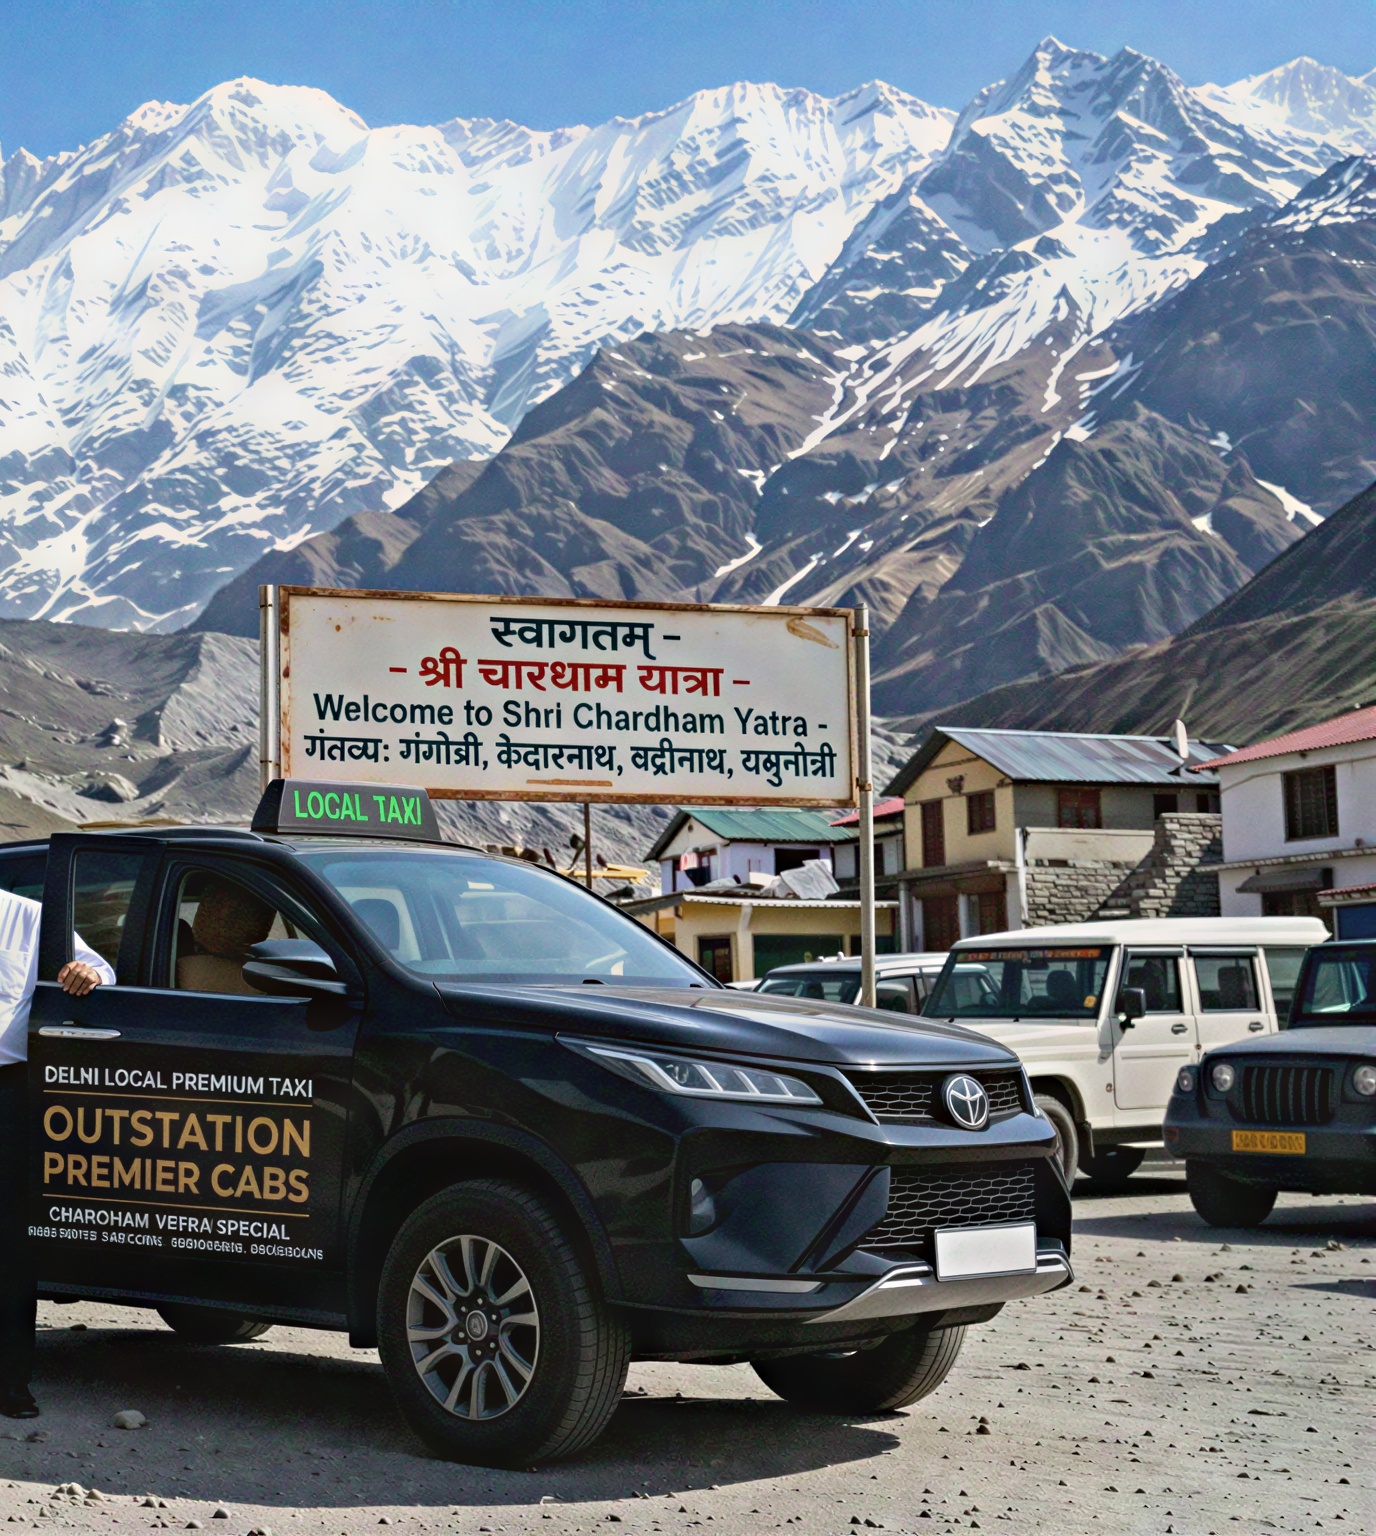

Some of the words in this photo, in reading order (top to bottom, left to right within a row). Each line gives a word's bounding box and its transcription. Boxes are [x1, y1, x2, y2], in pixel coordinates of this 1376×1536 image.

[489, 616, 657, 661] स्वागतम्
[418, 646, 468, 689] श्री
[477, 658, 627, 693] चारधाम
[636, 664, 725, 697] यात्रा
[312, 692, 454, 726] Welcome
[463, 699, 493, 727] to
[502, 699, 562, 729] Shri
[573, 702, 725, 735] Chardham
[733, 706, 808, 738] Yatra
[495, 732, 624, 777] केदारनाथ,
[293, 789, 369, 822] LOCAL
[372, 794, 423, 826] TAXI
[104, 1068, 168, 1089] LOCAL
[172, 1072, 264, 1095] PREMIUM
[268, 1077, 313, 1098] TAXI
[43, 1105, 311, 1158] OUTSTATION
[43, 1151, 201, 1194] PREMIER
[211, 1163, 310, 1203] CABS
[216, 1219, 291, 1241] SPECIAL
